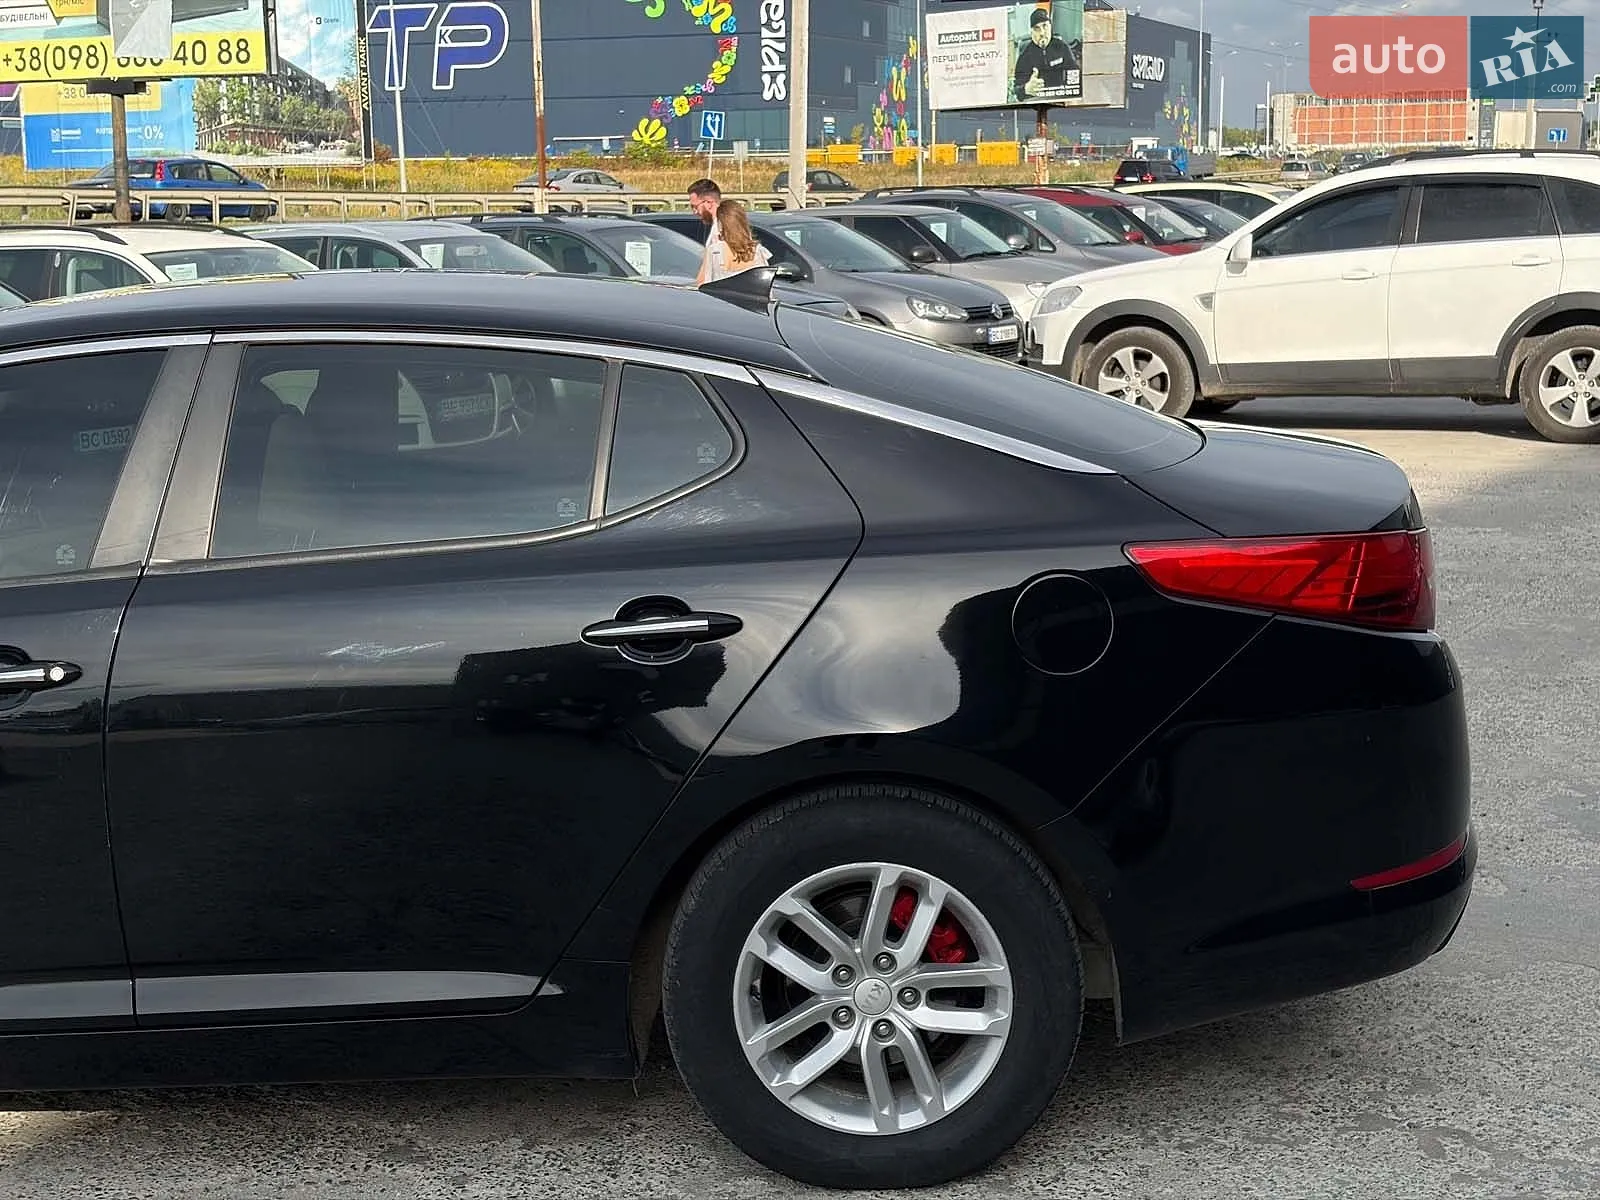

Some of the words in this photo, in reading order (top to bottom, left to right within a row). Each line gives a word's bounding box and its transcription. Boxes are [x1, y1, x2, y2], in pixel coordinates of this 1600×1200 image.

[359, 37, 367, 68] PARK
[940, 31, 978, 43] Autopark
[3, 41, 108, 78] +38(098)
[173, 40, 206, 66] 40
[217, 38, 250, 64] 88
[360, 71, 369, 110] AVANT
[80, 433, 101, 449] BC
